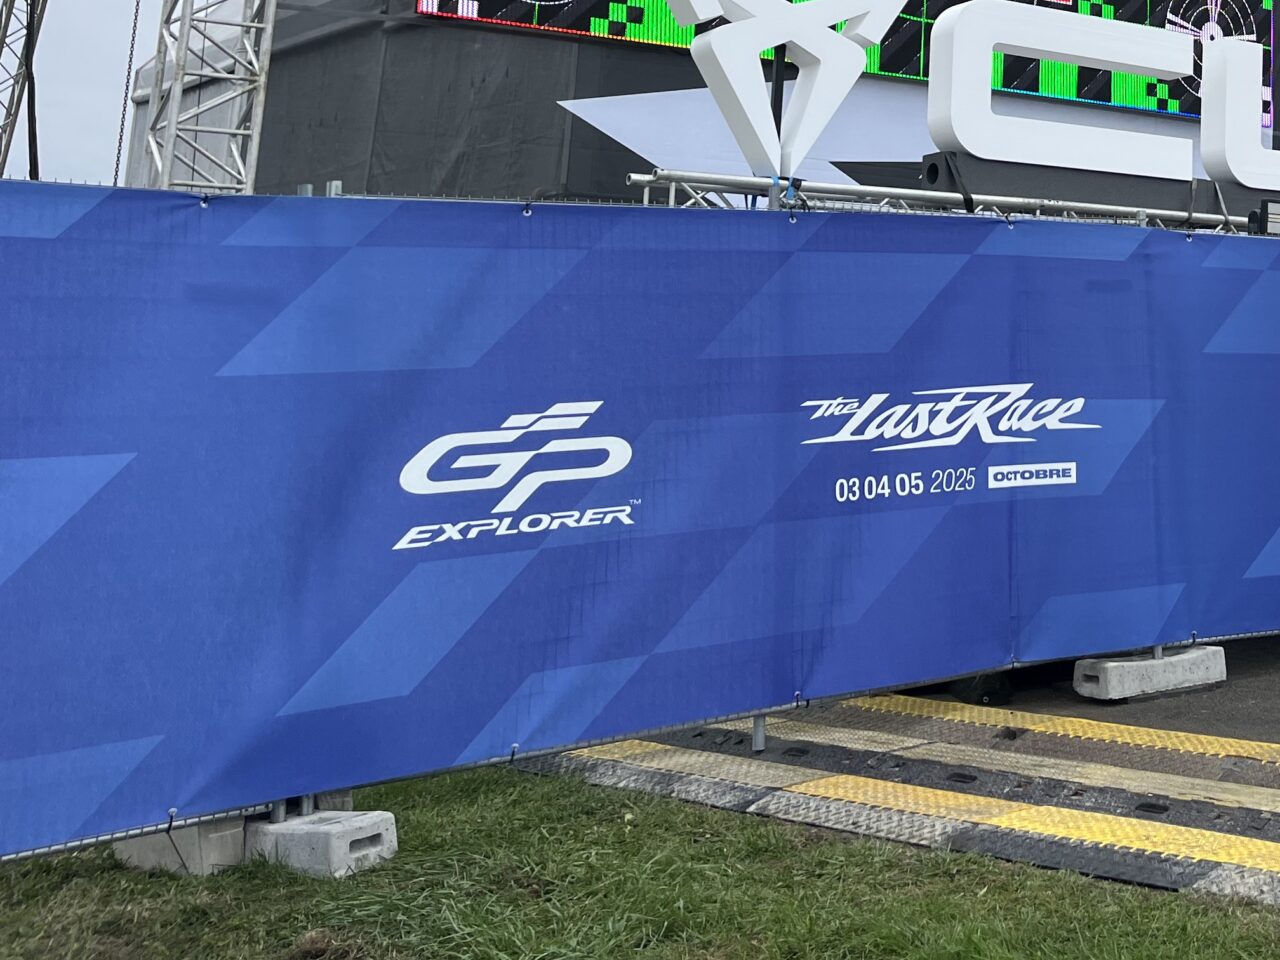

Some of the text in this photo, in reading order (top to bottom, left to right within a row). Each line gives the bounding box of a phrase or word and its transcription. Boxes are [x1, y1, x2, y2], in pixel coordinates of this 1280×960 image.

[400, 401, 632, 513] GP
[930, 467, 976, 493] 2025
[992, 468, 1072, 482] OCTOBRE
[392, 506, 634, 550] EXPLORER
